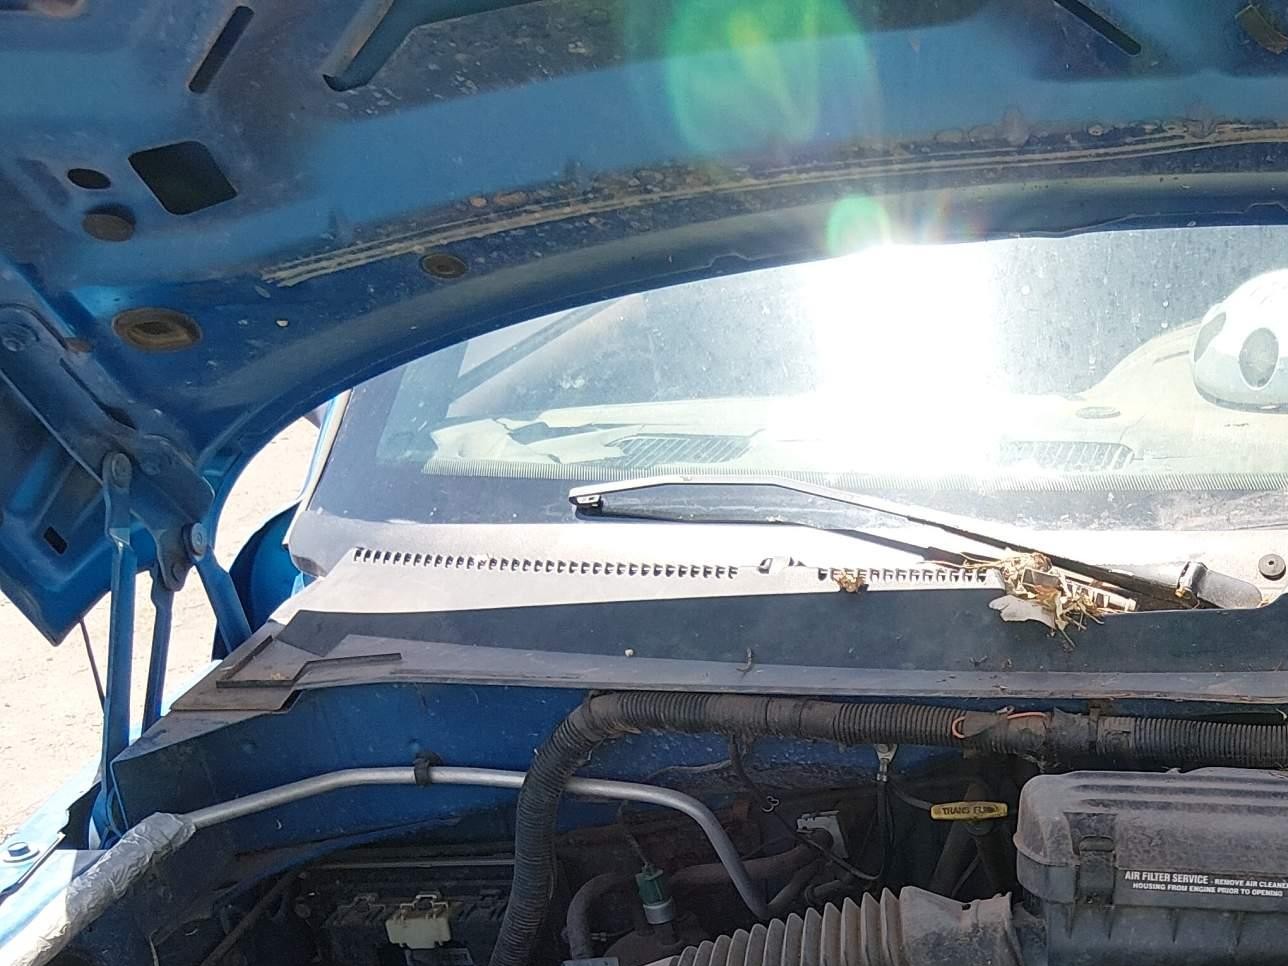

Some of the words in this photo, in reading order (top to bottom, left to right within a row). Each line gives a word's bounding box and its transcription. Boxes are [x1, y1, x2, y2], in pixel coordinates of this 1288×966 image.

[942, 806, 970, 815] TRANS
[1125, 871, 1140, 880] AIR
[1142, 872, 1170, 882] FILTER
[1172, 873, 1208, 884] SERVICE
[1214, 878, 1243, 886] REMOVE
